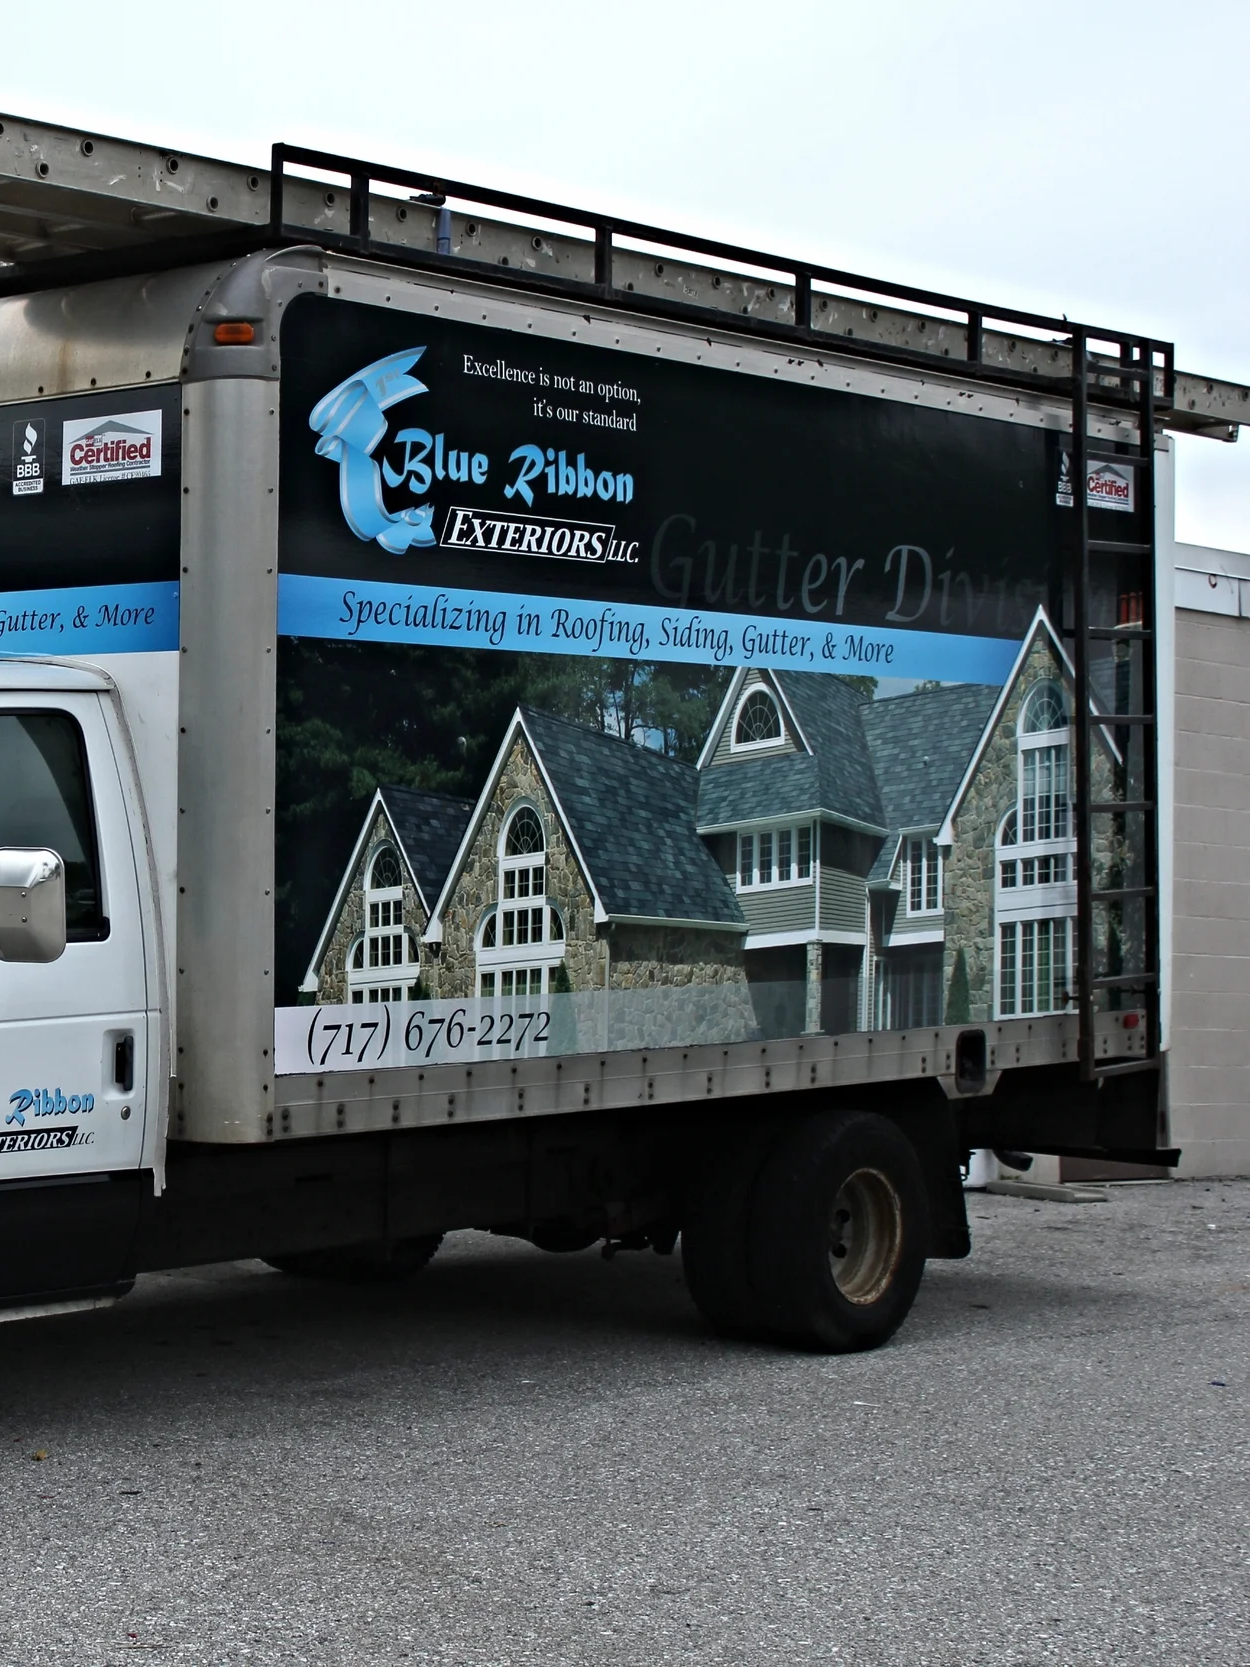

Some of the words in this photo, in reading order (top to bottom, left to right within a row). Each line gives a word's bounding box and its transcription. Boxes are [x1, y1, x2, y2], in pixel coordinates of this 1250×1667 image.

[463, 354, 535, 384] Excellence
[539, 367, 550, 386] is
[553, 375, 576, 391] not
[579, 379, 594, 394] an
[597, 381, 641, 405] option,
[533, 397, 553, 418] it's
[556, 406, 579, 422] our
[582, 409, 637, 432] standard
[70, 436, 151, 466] Certified
[382, 427, 489, 494] Blue
[503, 444, 634, 508] Ribbon
[14, 480, 41, 488] ACCREDITED
[17, 463, 40, 478] BBB
[1087, 476, 1129, 498] Certified
[447, 509, 607, 560] EXTERIORS
[607, 539, 639, 563] LLC.
[649, 513, 866, 616] Gutter
[72, 608, 90, 629] &
[96, 604, 155, 628] More
[339, 590, 506, 645] Specializing
[516, 604, 542, 636] in
[550, 608, 651, 655] Roofing,
[658, 615, 734, 661] Siding,
[742, 624, 814, 662] Gutter,
[821, 632, 837, 660] &
[842, 634, 894, 664] More
[307, 1004, 391, 1066] (717)
[404, 1008, 551, 1058] 676-2272
[5, 1087, 95, 1127] Ribbon
[72, 1131, 95, 1146] LLC.
